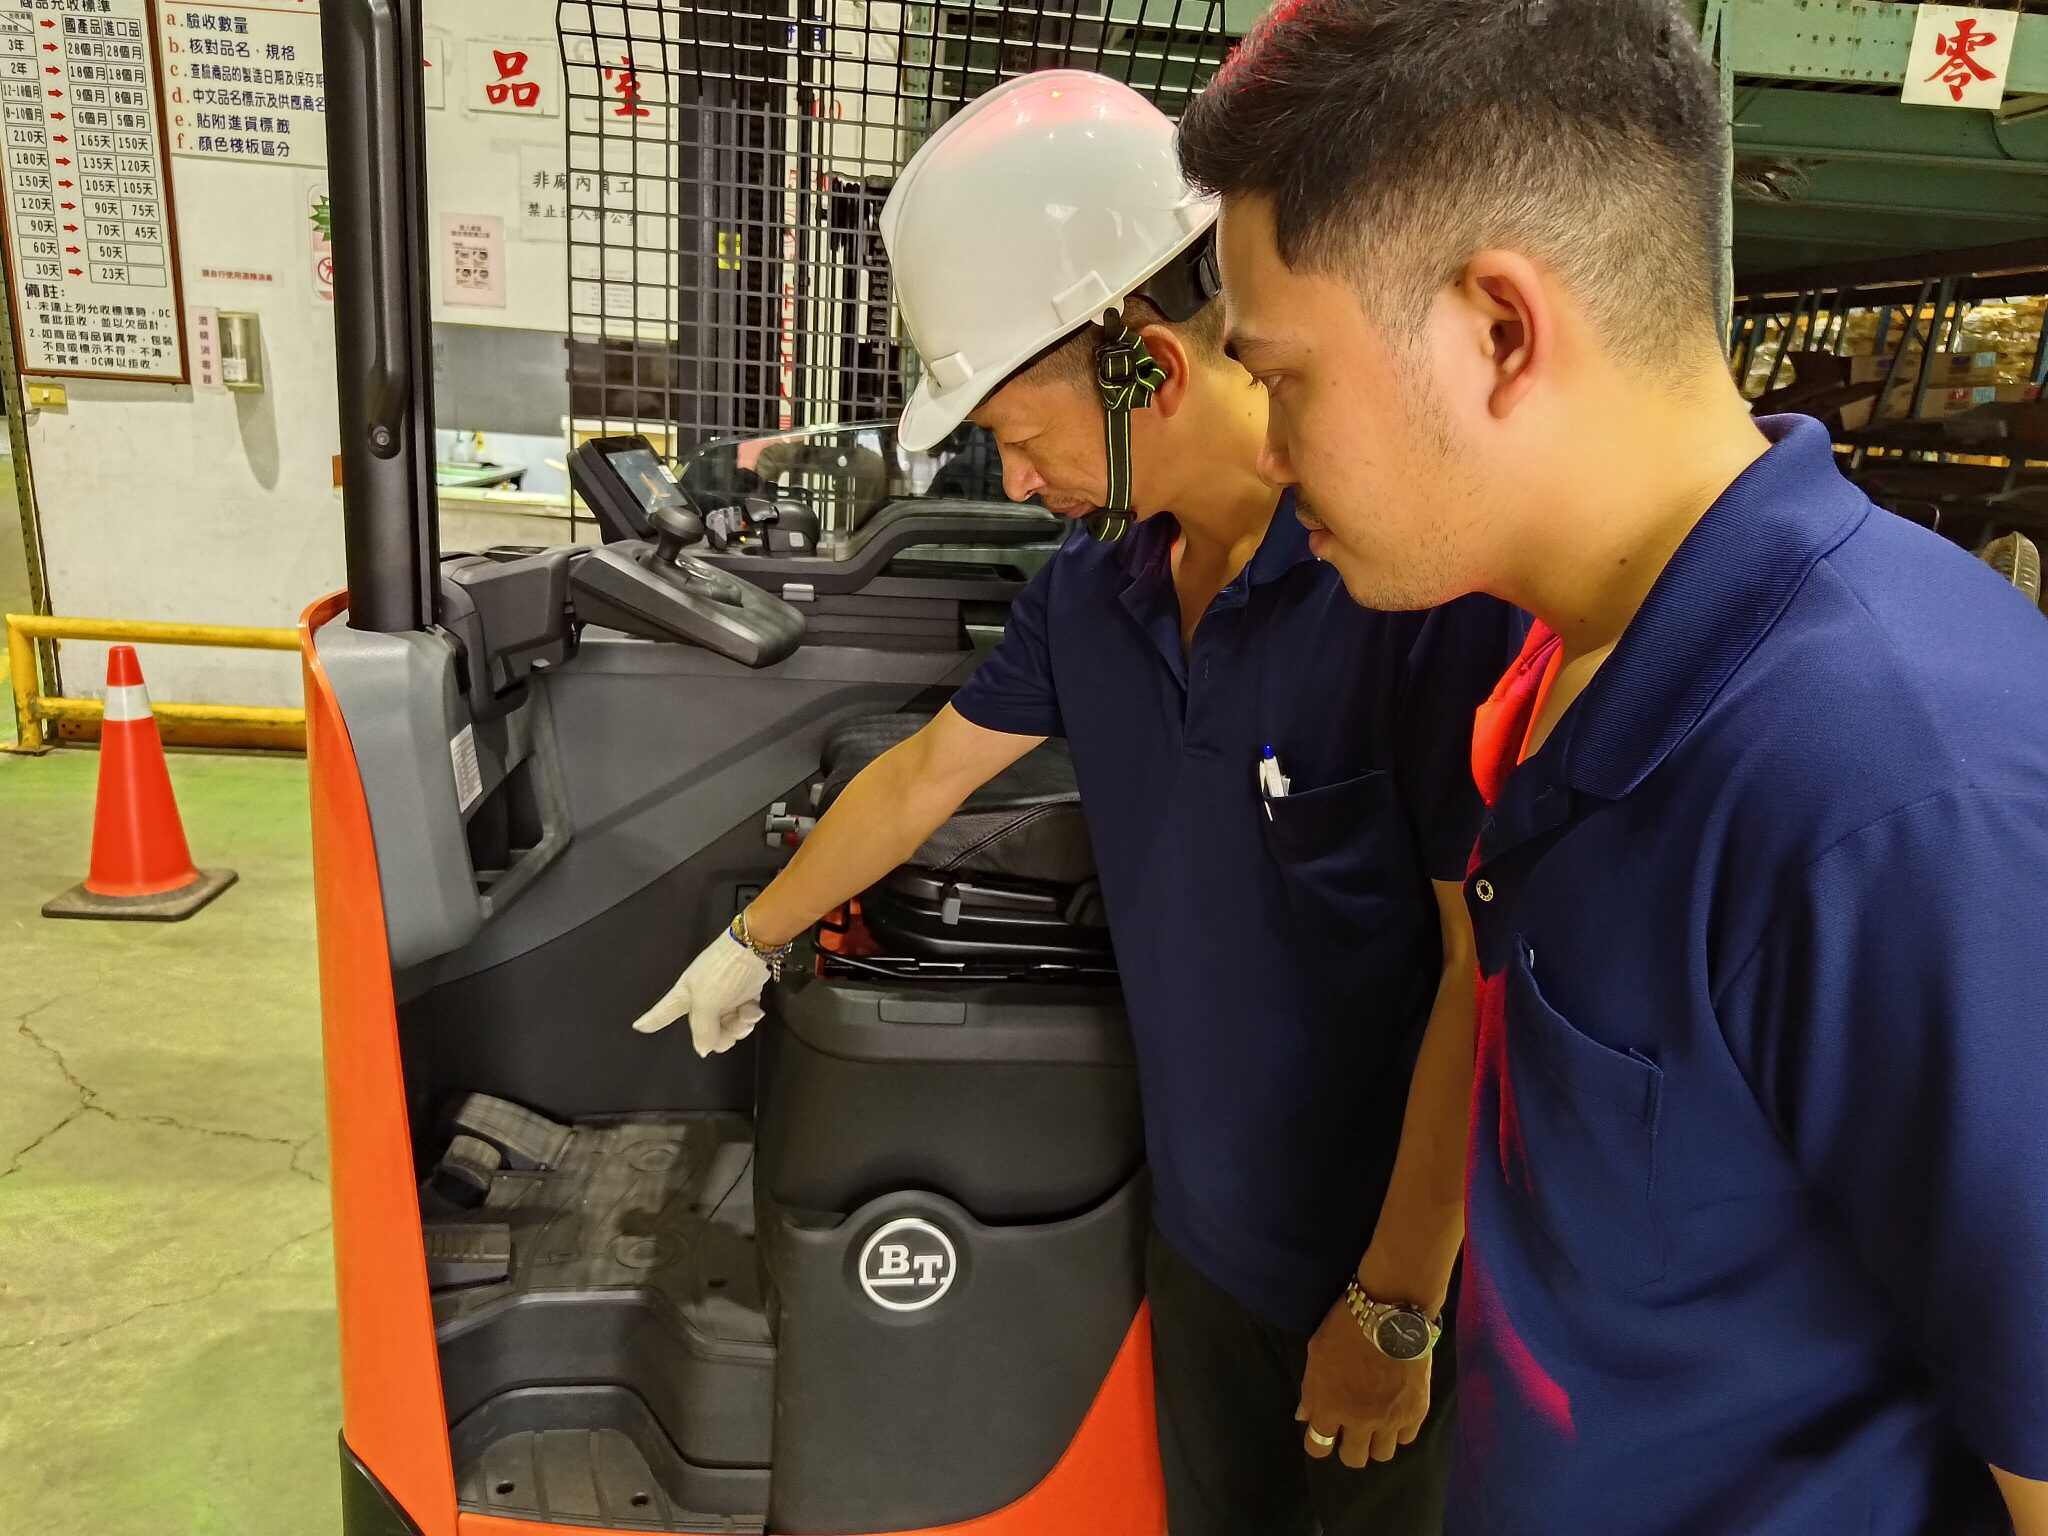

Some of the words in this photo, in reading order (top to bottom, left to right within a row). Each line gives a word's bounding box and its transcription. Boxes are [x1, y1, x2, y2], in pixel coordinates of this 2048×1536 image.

[64, 18, 100, 34] 國產品
[104, 19, 140, 37] 進口品
[8, 39, 25, 52] 3年
[68, 43, 104, 57] 28個月
[107, 45, 142, 60] 28個月
[1923, 18, 1998, 102] 零
[11, 62, 27, 75] 2年
[70, 66, 106, 80] 18個月
[109, 69, 145, 83] 18個月
[76, 89, 105, 103] 9個月
[115, 91, 144, 106] 8個月
[79, 112, 108, 126] 6個月
[117, 114, 146, 129] 5個月
[14, 129, 45, 144] 210天
[81, 134, 111, 149] 165天
[118, 137, 148, 151] 150天
[16, 152, 48, 167] 180天
[83, 157, 114, 171] 135天
[121, 160, 151, 174] 120天
[19, 175, 50, 189] 150天
[86, 180, 116, 193] 105天
[123, 182, 153, 196] 105天
[21, 197, 53, 212] 120天
[94, 202, 119, 216] 90天
[132, 204, 156, 218] 75天
[30, 219, 56, 234] 90天
[97, 224, 121, 238] 70天
[134, 226, 158, 240] 45天
[33, 241, 58, 255] 60天
[99, 246, 123, 259] 50天
[36, 263, 61, 277] 30天
[102, 267, 126, 281] 23天
[878, 1244, 944, 1286] BT
